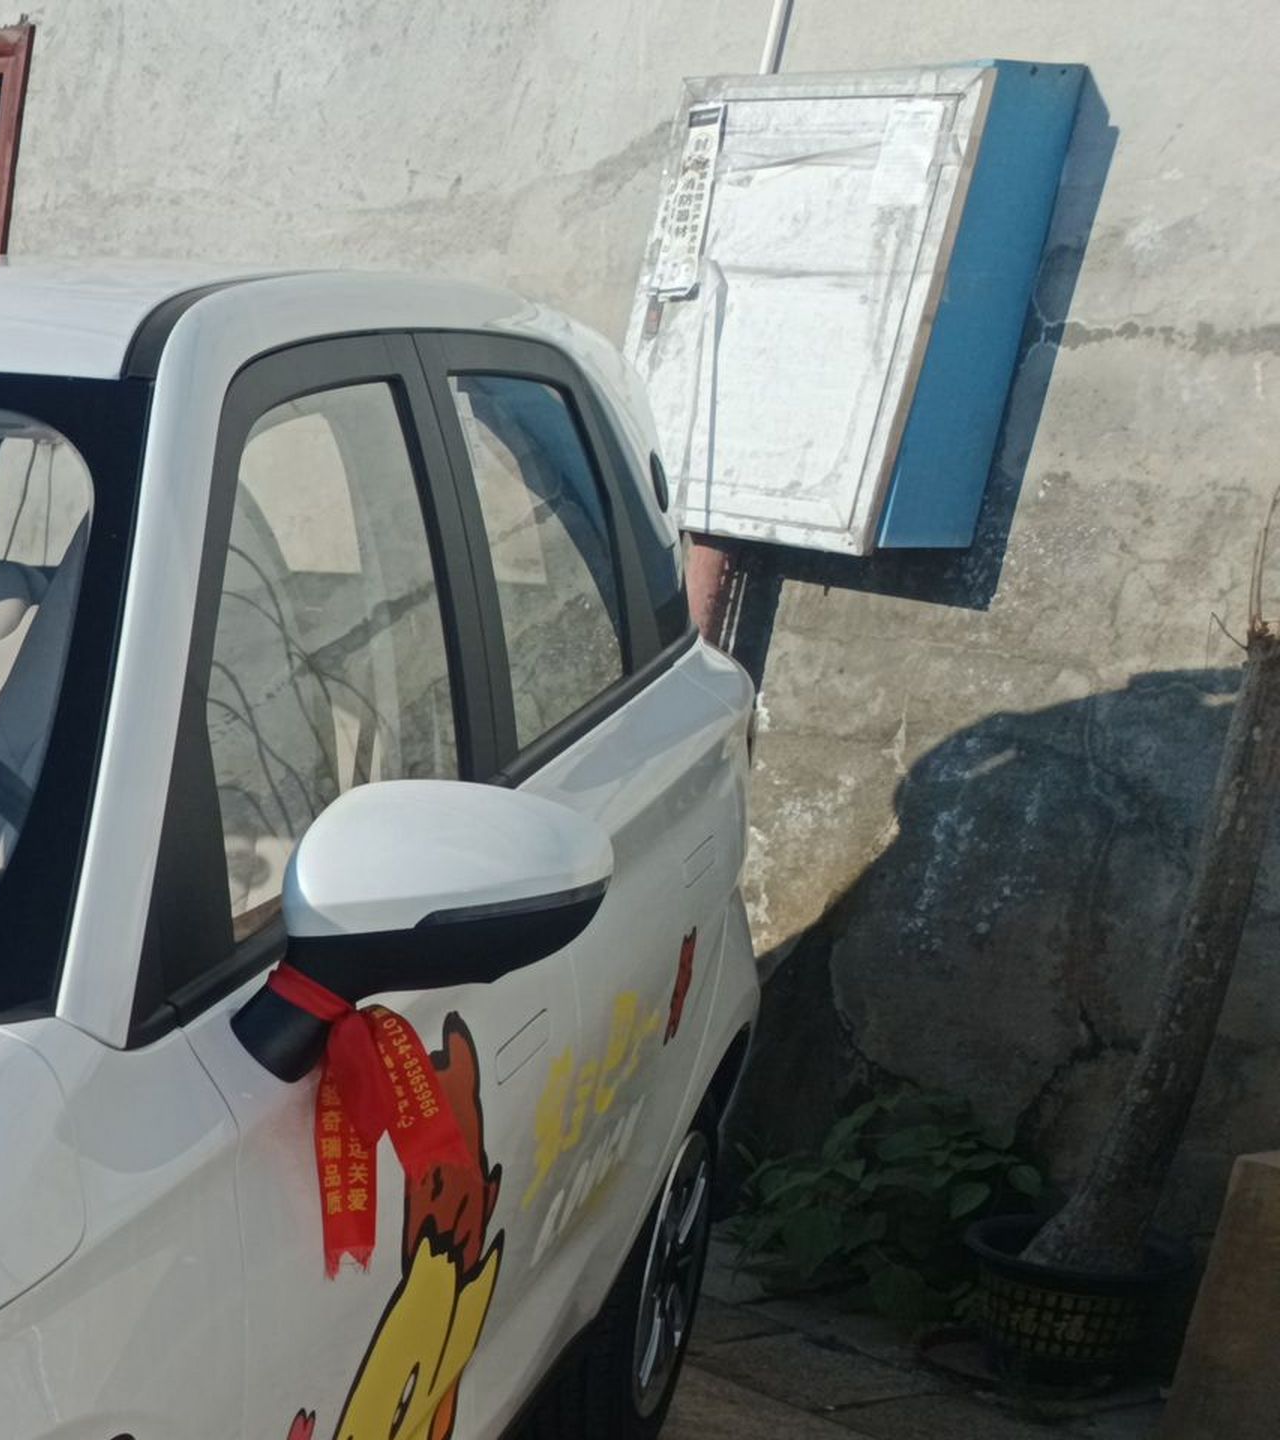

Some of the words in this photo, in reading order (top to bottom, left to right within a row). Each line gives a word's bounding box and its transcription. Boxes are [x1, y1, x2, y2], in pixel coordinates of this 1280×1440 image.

[321, 1072, 342, 1216] 验奇瑞品质
[347, 1126, 369, 1211] 远关爱
